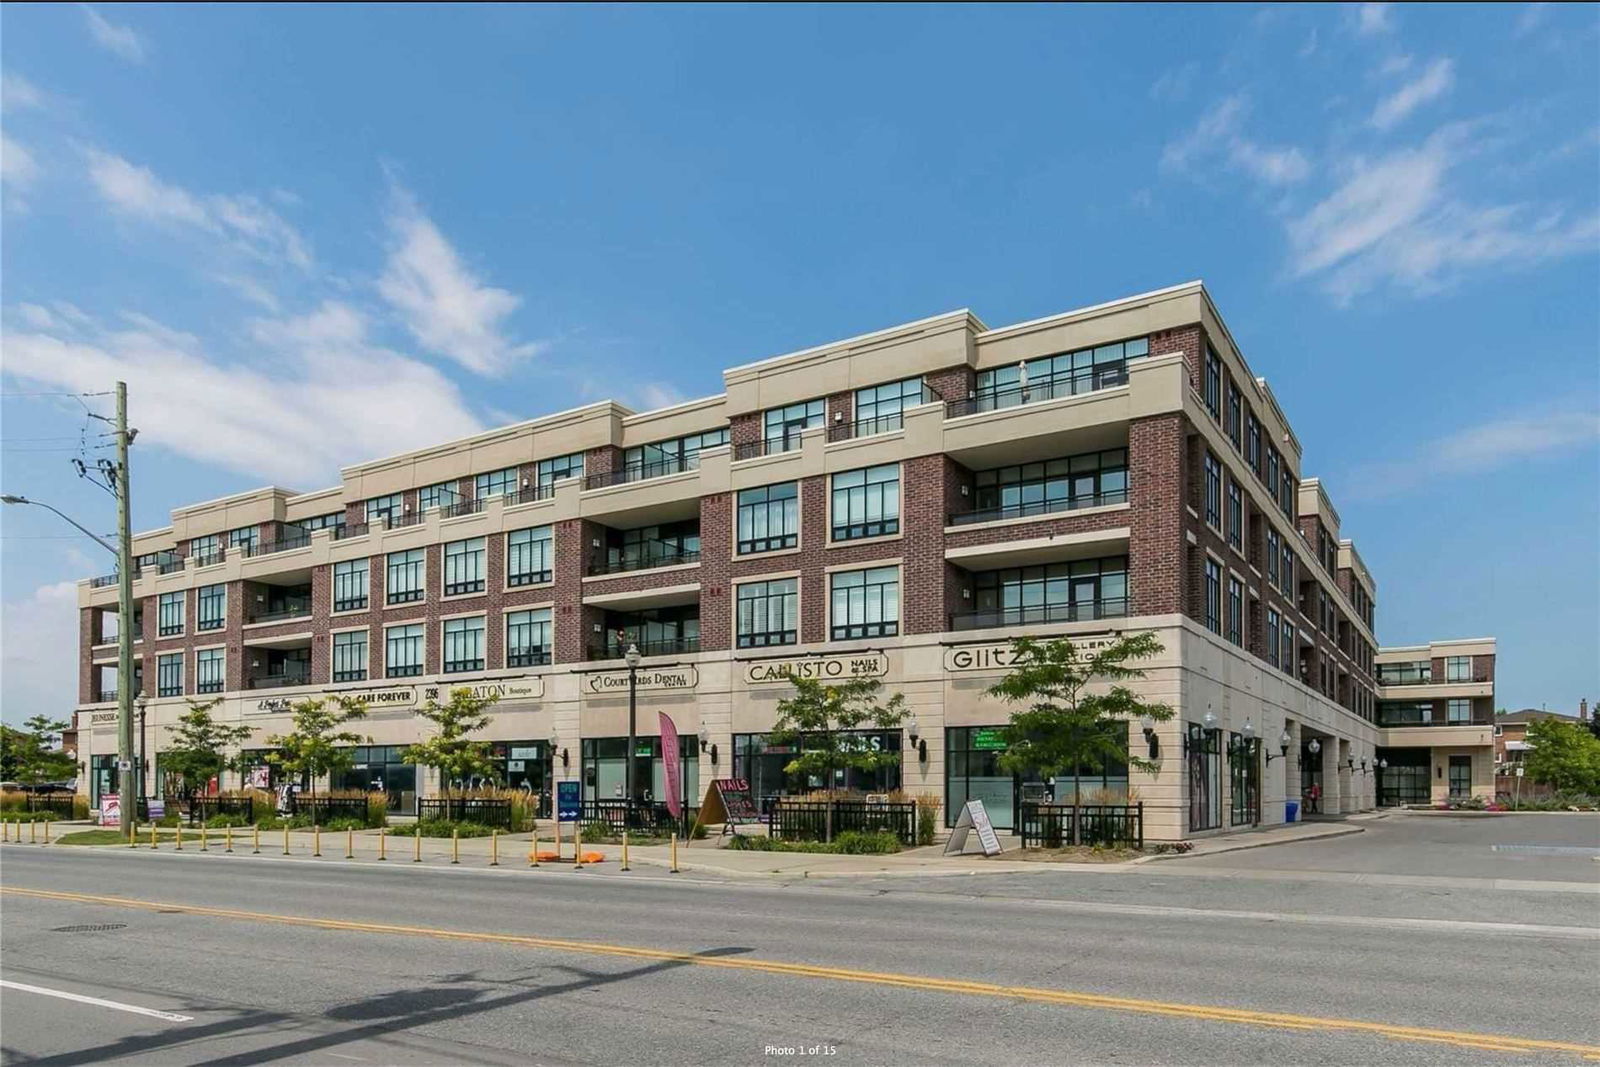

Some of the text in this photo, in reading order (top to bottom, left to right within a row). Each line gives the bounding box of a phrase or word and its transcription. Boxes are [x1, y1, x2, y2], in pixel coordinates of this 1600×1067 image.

[850, 659, 878, 667] NAILS
[654, 673, 687, 684] DENTAL
[377, 691, 411, 702] FOREVER
[719, 779, 749, 792] NAILS
